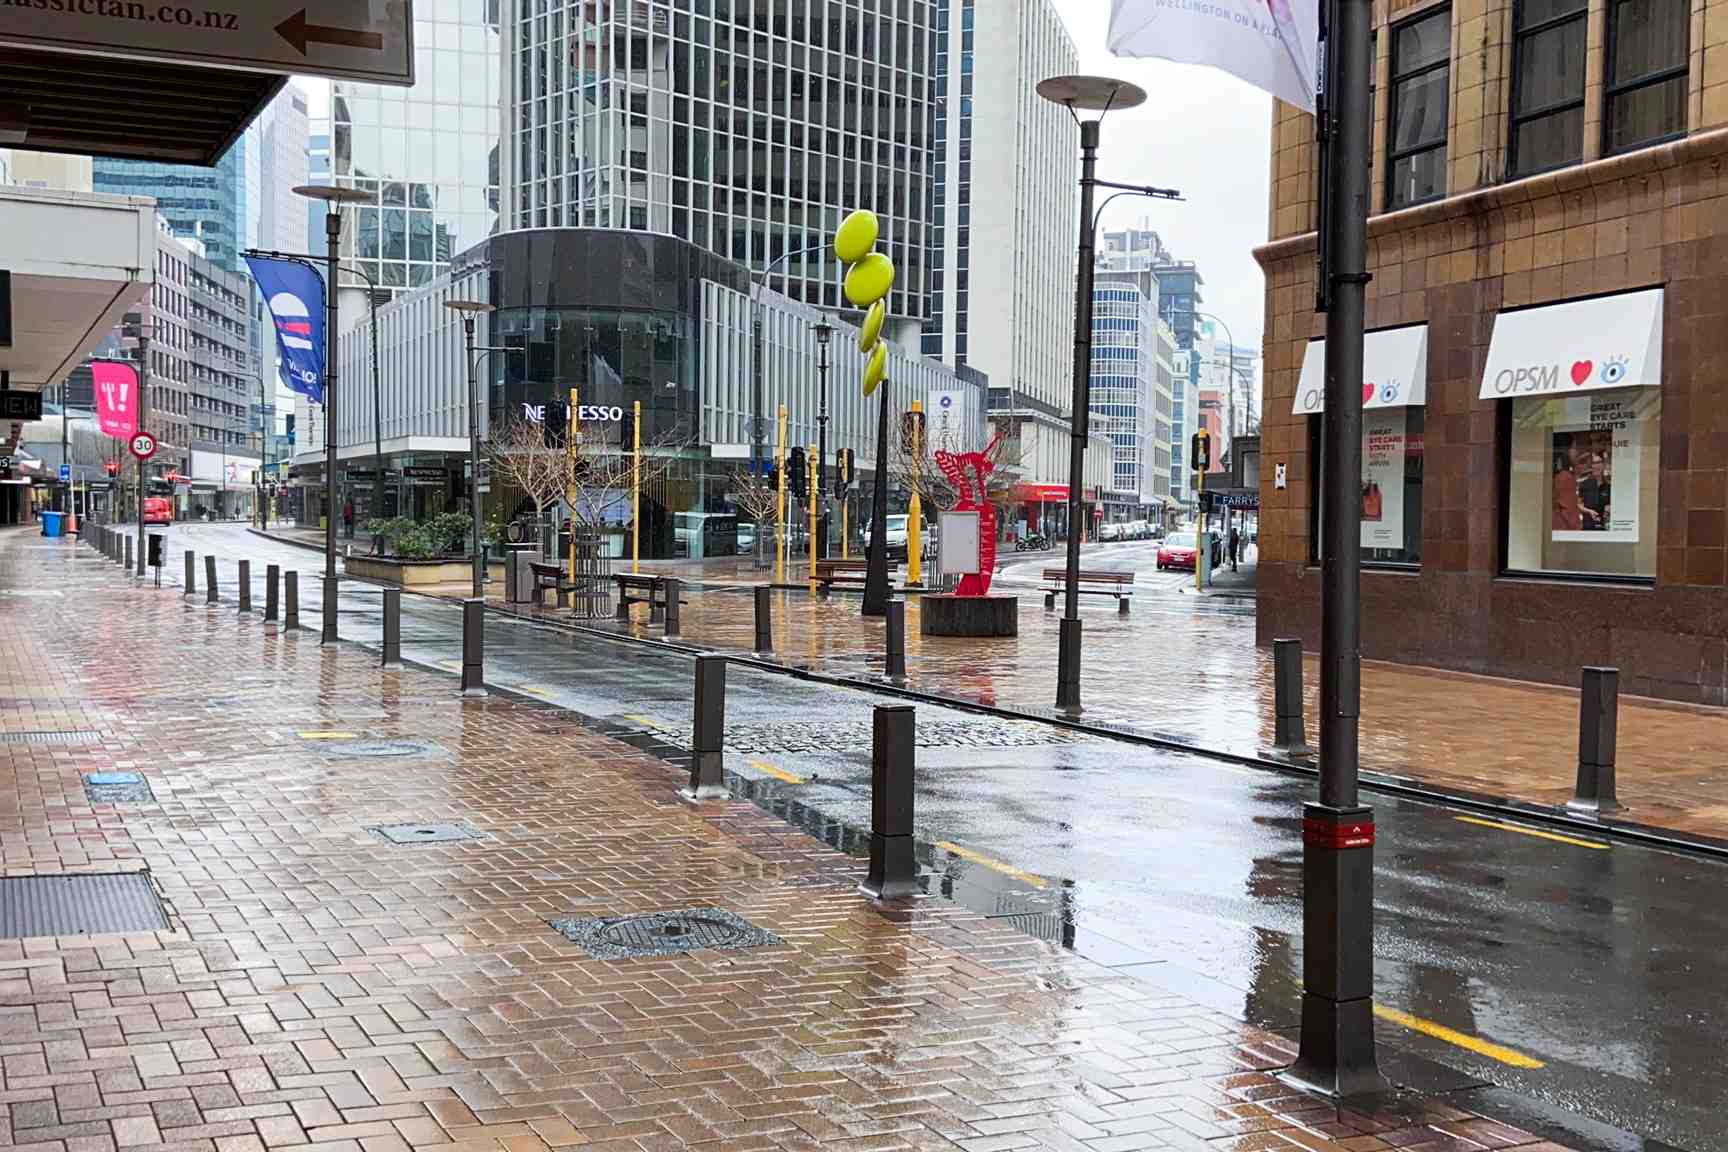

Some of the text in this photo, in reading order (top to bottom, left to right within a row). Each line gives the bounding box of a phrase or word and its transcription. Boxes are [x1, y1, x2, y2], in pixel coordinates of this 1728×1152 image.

[1, 0, 239, 30] assictan.co.nz
[1155, 0, 1232, 21] WELLINGTON
[1234, 13, 1249, 26] ON
[1495, 365, 1559, 394] OPSM
[522, 402, 623, 422] NEESSO
[1590, 402, 1622, 412] GREAT
[1590, 421, 1627, 432] STARTS
[135, 440, 152, 450] 30
